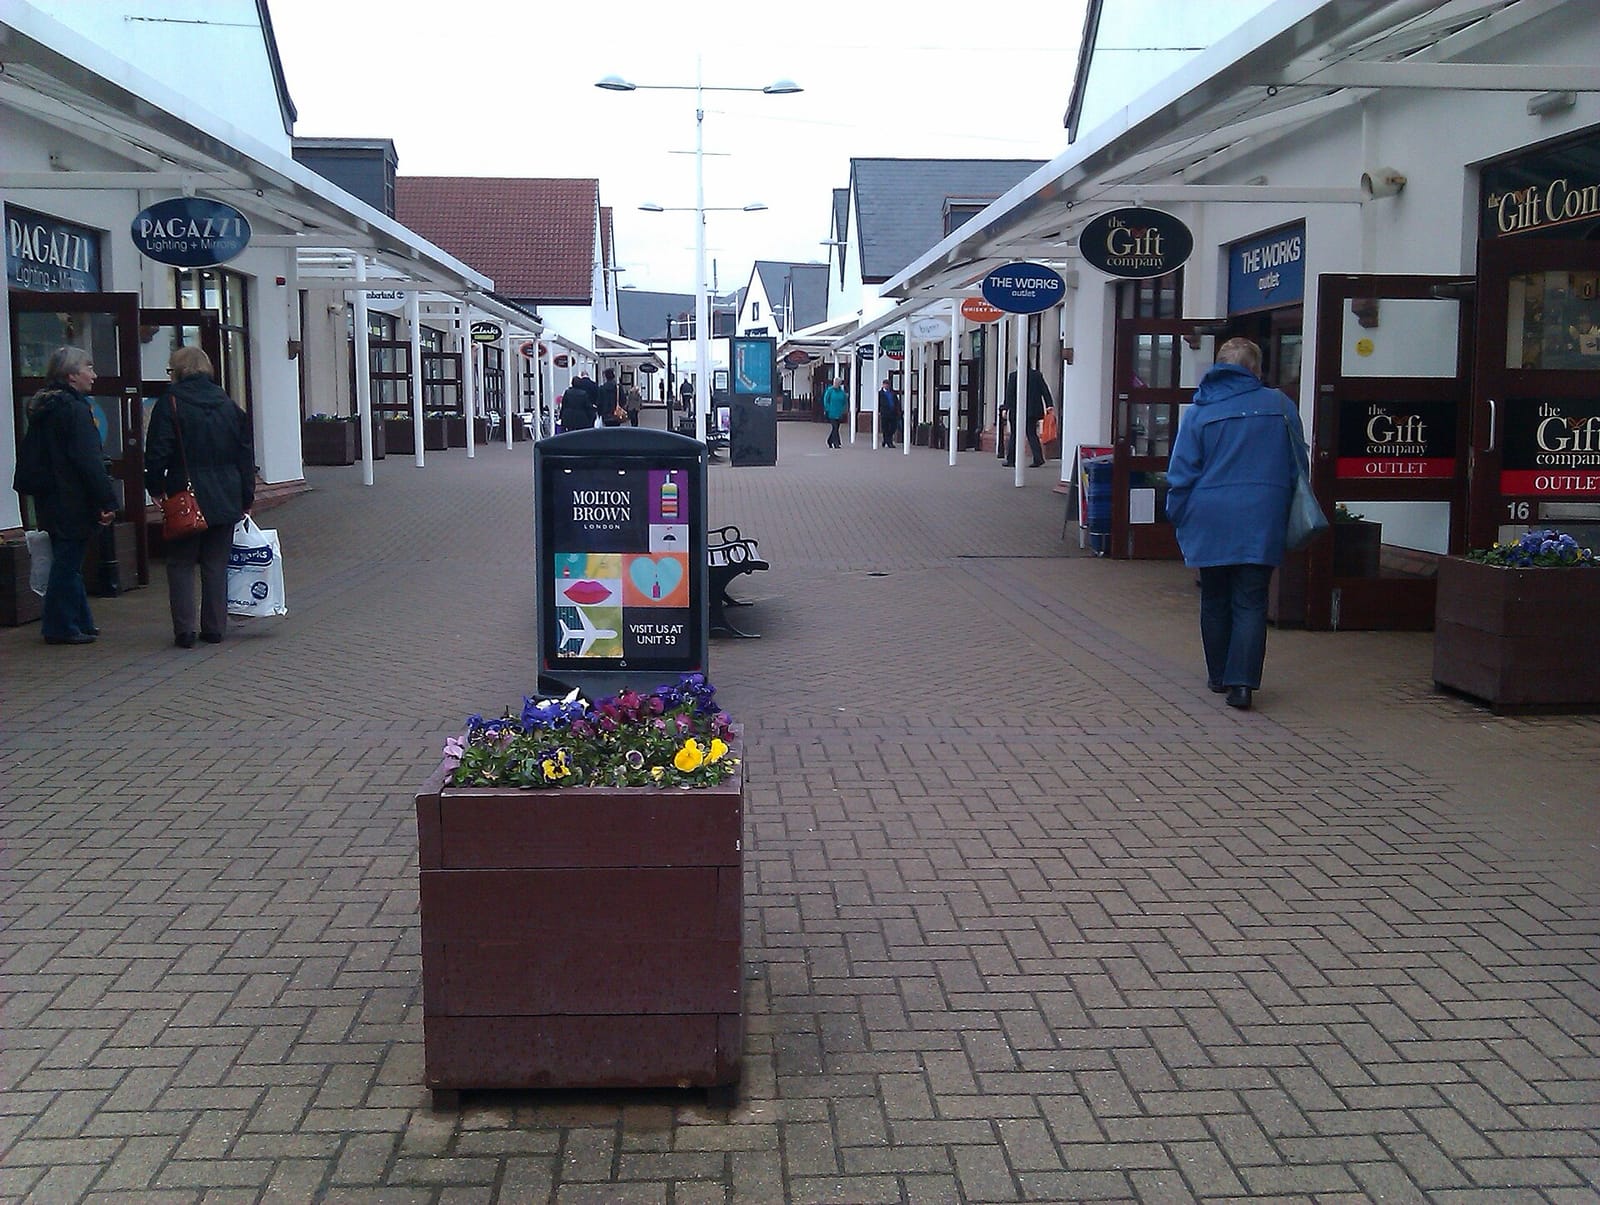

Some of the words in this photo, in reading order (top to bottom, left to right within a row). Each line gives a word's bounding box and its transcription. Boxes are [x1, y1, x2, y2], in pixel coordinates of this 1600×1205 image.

[1498, 186, 1541, 232] Gift
[141, 218, 241, 238] PAGAZZI
[1108, 216, 1126, 227] the
[9, 219, 89, 272] PAGAZZI
[146, 240, 188, 252] Lighting
[201, 239, 238, 249] Mirrors
[1106, 228, 1164, 255] Gift
[1242, 249, 1260, 274] THE
[1261, 237, 1301, 269] WORKS
[1106, 257, 1164, 269] company
[16, 262, 50, 291] Lighting
[990, 277, 1012, 287] THE
[1016, 278, 1059, 289] WORKS
[1259, 272, 1280, 290] outlet
[471, 325, 499, 334] Clarks
[1368, 404, 1386, 415] the
[1539, 403, 1560, 417] the
[1367, 415, 1429, 443] Gift
[1366, 446, 1427, 457] company
[1365, 462, 1427, 474] OUTLET
[573, 491, 631, 504] MOLTON
[573, 507, 631, 521] BROWN
[1507, 502, 1530, 520] 16
[630, 624, 653, 633] VISIT
[656, 625, 669, 634] US
[670, 624, 684, 634] AT
[637, 635, 662, 644] UNIT
[665, 636, 676, 645] 53
